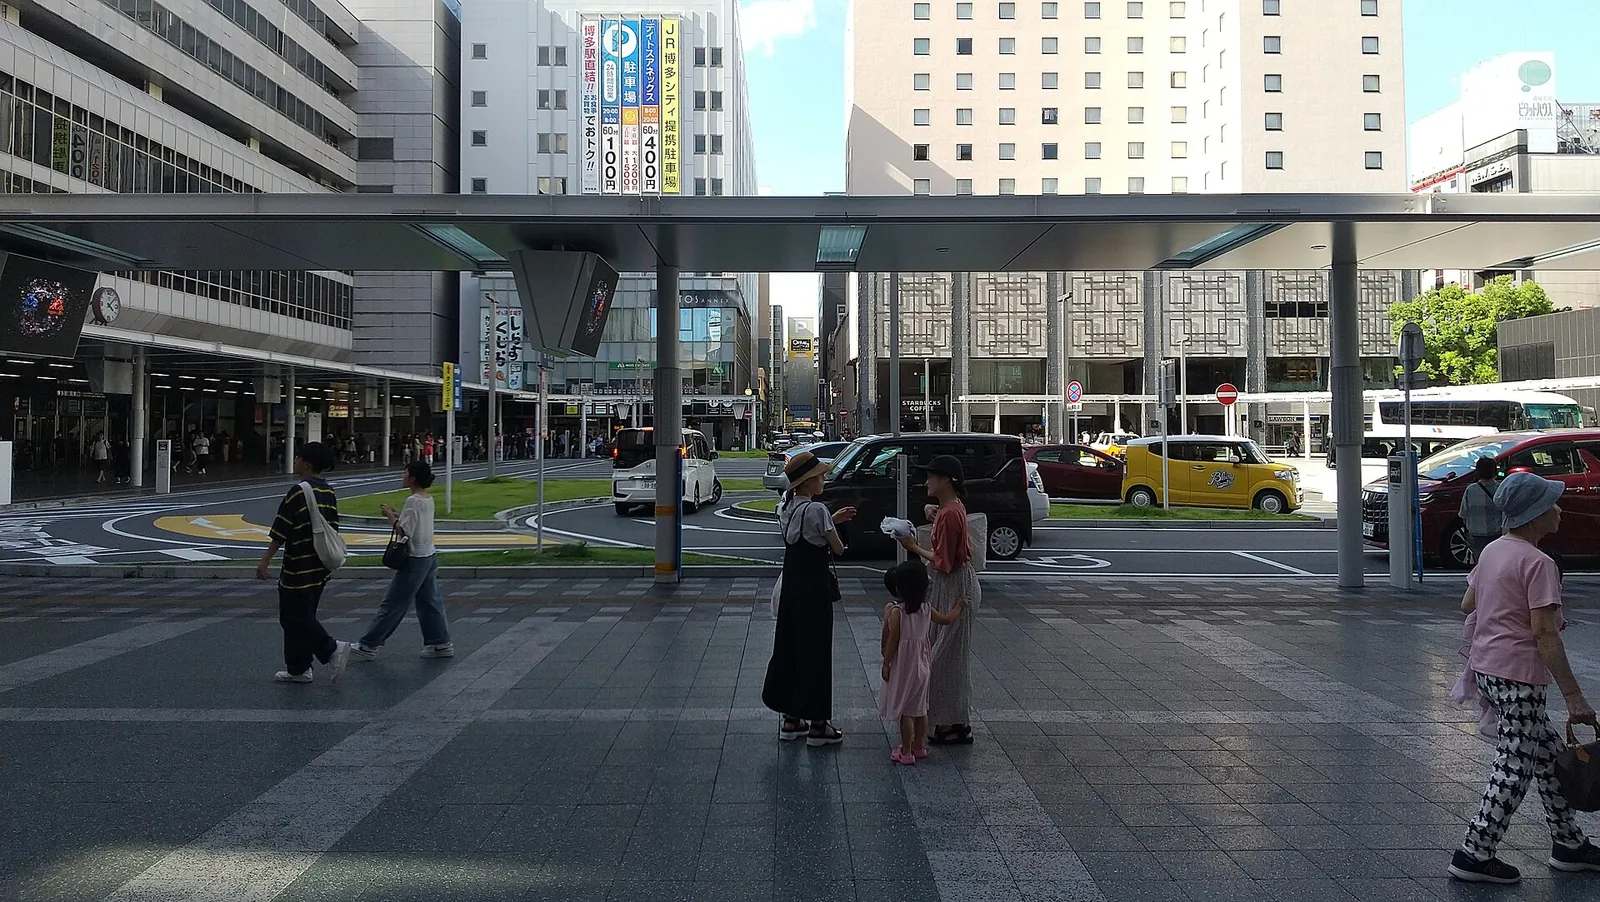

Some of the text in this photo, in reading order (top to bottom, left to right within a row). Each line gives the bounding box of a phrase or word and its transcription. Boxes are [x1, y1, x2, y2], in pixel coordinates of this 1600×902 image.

[611, 29, 630, 53] P
[645, 22, 656, 102] デイトスアネックス
[623, 61, 637, 104] 駐車場
[664, 23, 677, 188] JR博多シティ 提携駐車場
[1518, 102, 1553, 117] ピタットハウス
[495, 321, 509, 367] くじら
[509, 316, 522, 361] しらす
